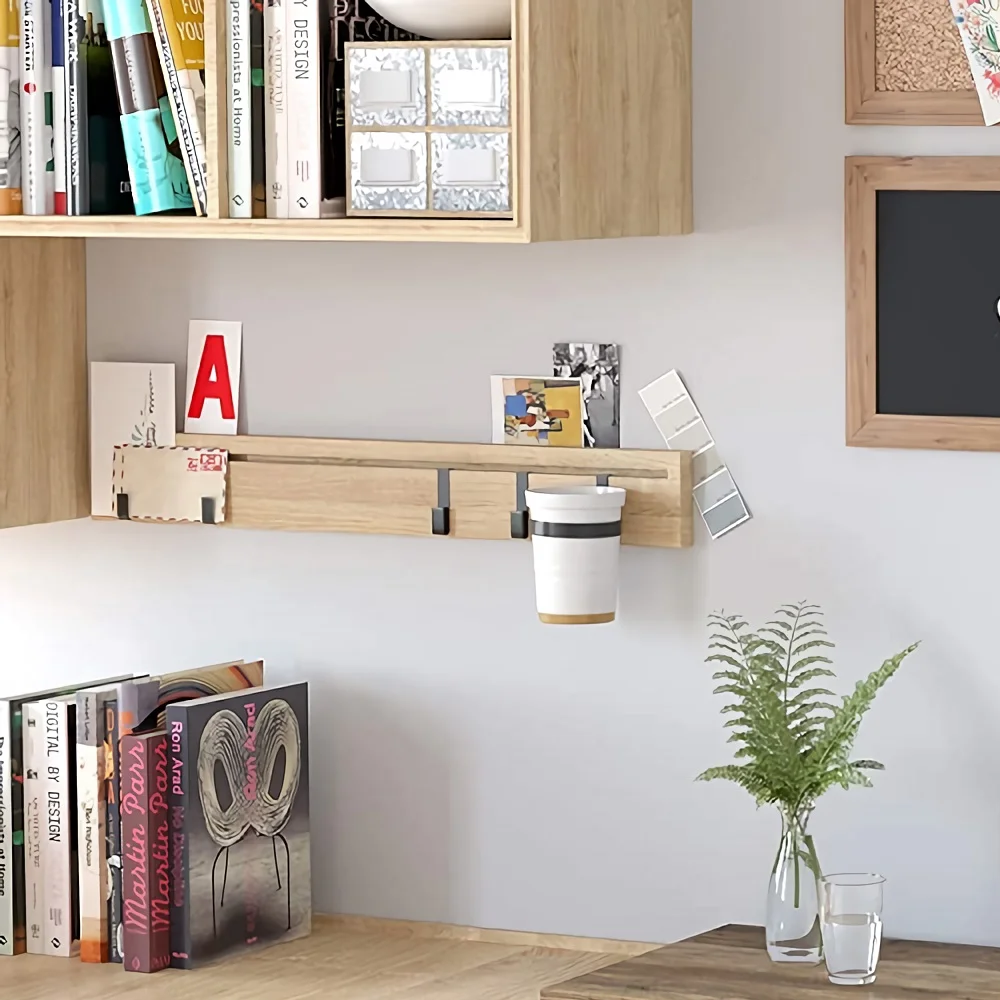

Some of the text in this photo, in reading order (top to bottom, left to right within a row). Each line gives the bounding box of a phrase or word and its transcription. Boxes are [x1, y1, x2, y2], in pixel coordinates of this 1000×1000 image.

[294, 20, 309, 80] DESIGN
[233, 88, 242, 102] at
[233, 107, 243, 146] Home
[187, 334, 236, 420] A
[171, 721, 183, 752] Ron
[45, 702, 61, 842] DIGITAL BY DESIGN
[149, 738, 169, 814] Parr
[172, 757, 184, 796] Arad
[121, 739, 148, 935] Martin Parr
[151, 820, 170, 933] Martin
